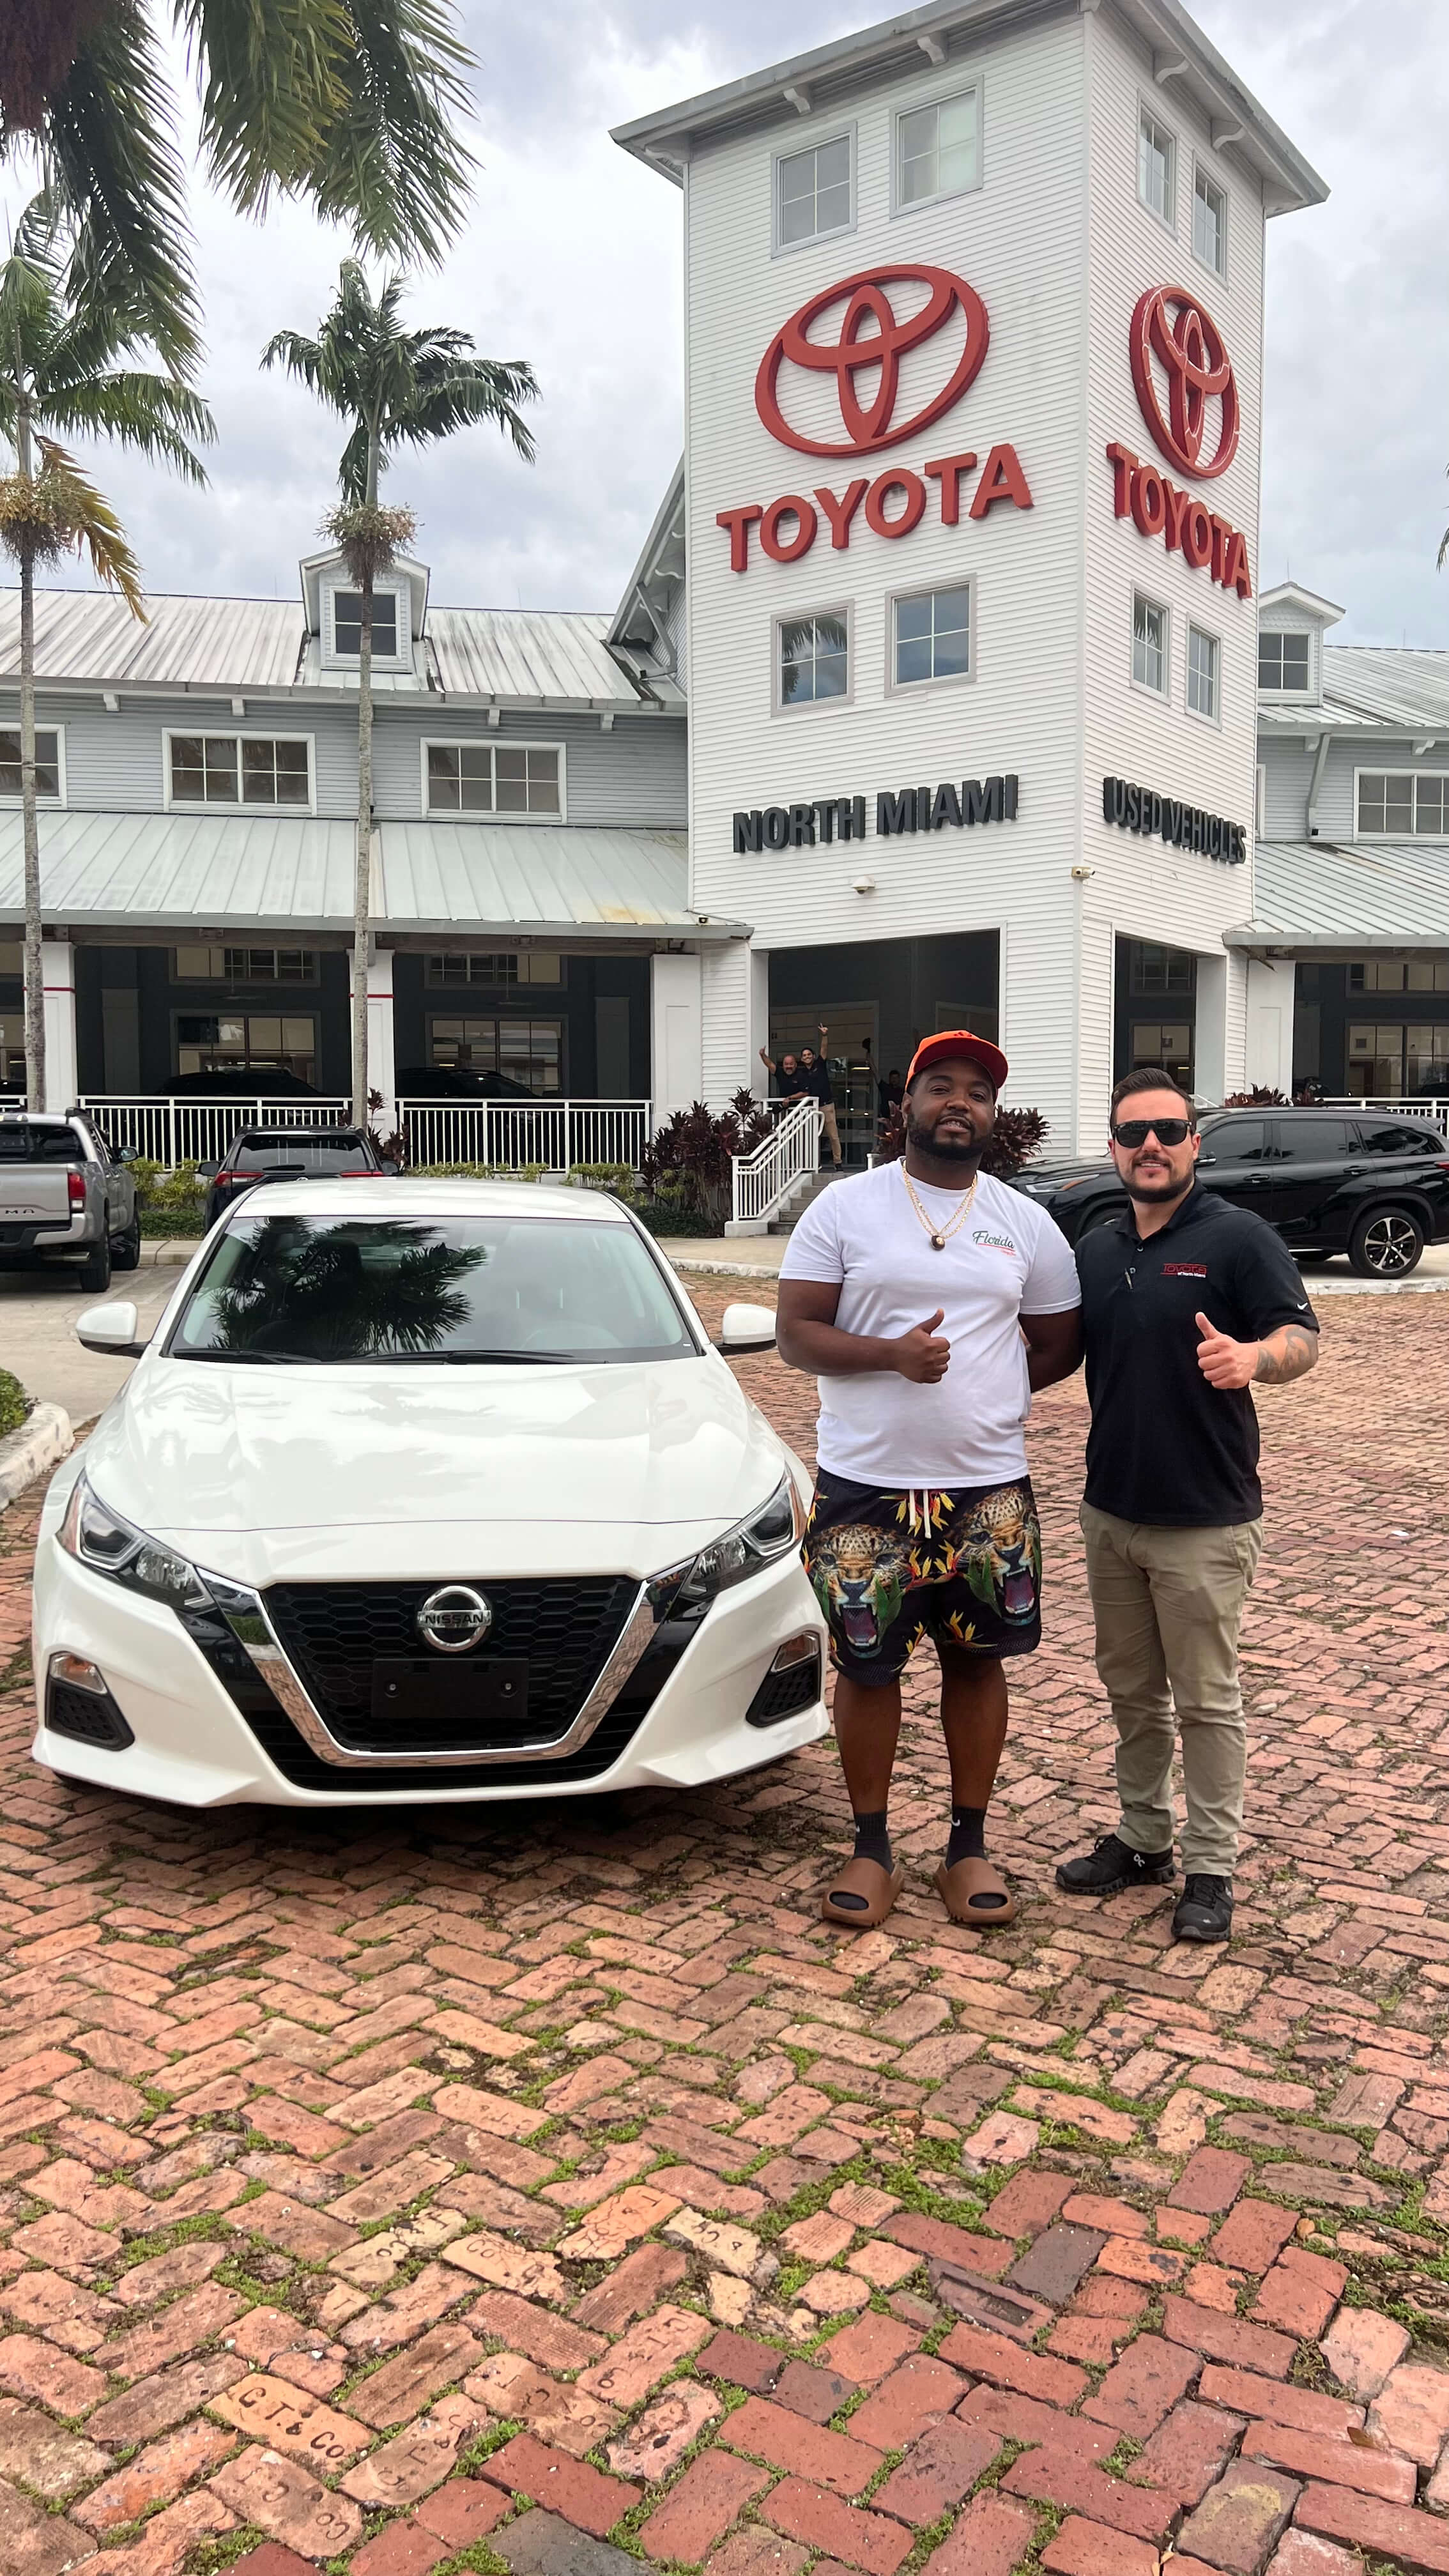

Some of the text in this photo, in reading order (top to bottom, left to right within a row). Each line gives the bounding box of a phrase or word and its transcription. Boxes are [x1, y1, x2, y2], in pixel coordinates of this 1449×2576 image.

[716, 443, 1034, 572] TOYOTA
[1106, 442, 1252, 599] TOYOTA
[733, 774, 1019, 853] NORTH MIAMI
[1103, 776, 1246, 864] USED VEHICLES
[972, 1230, 1015, 1249] Florida
[425, 1613, 483, 1625] NISSAN
